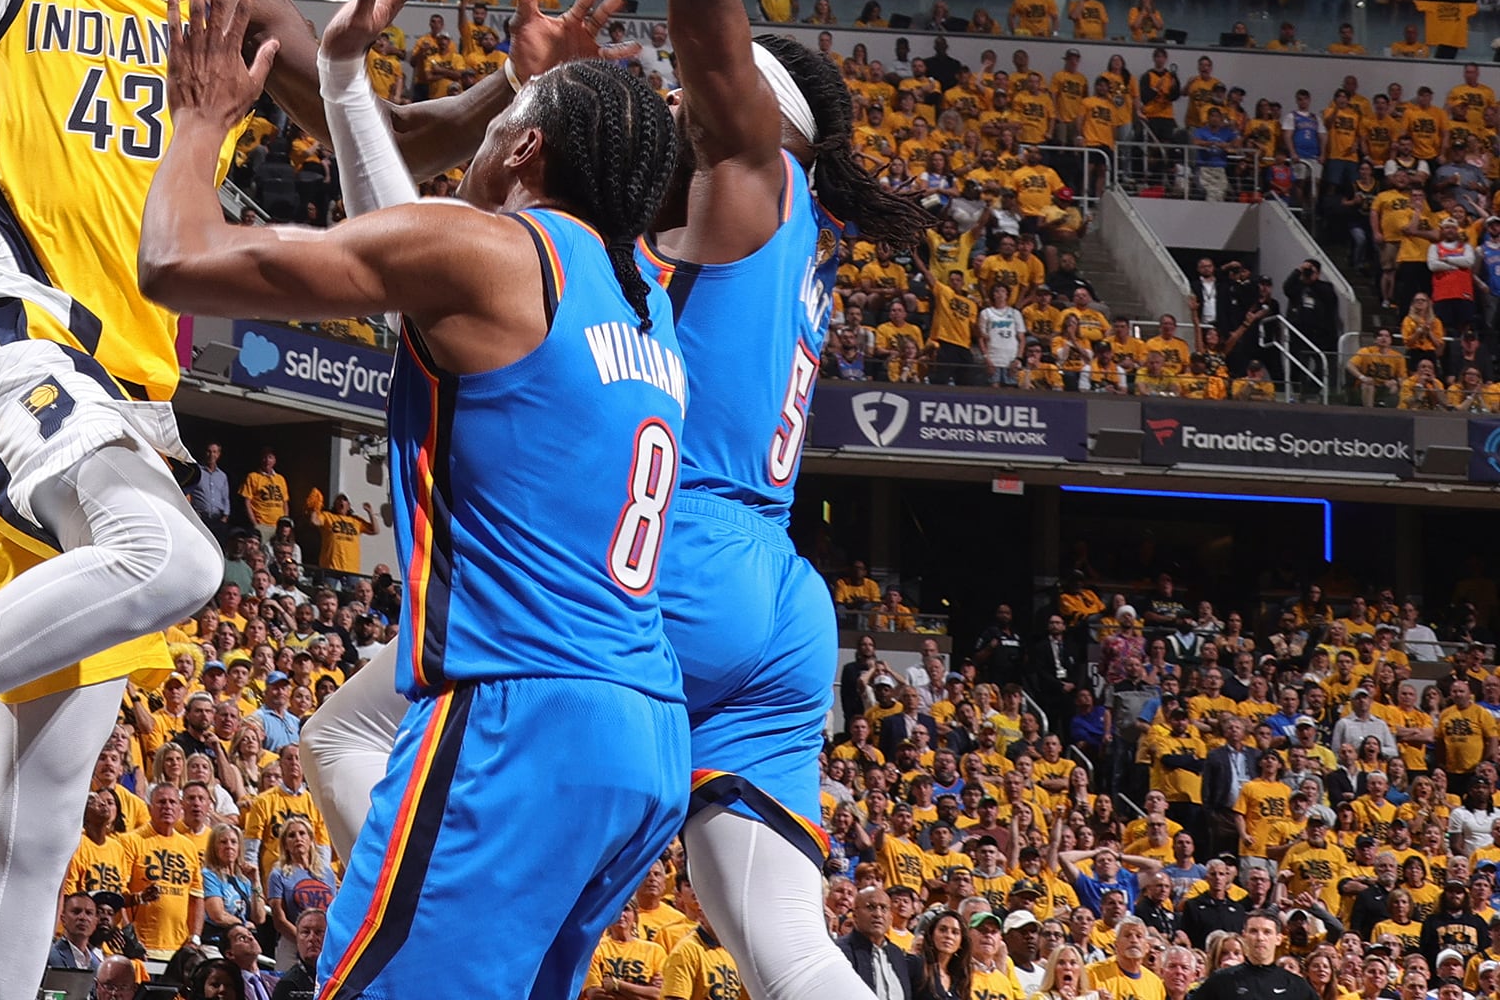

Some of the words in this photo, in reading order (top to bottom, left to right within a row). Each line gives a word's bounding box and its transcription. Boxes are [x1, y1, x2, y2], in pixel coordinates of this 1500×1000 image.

[25, 1, 172, 66] INDIAN
[65, 66, 168, 161] 43
[284, 346, 390, 399] salesforc
[583, 320, 687, 421] WILLIAM
[768, 336, 820, 488] 5
[919, 401, 1047, 429] FANDUEL
[919, 426, 976, 442] SPORTS
[977, 428, 1047, 446] NETWORK
[1181, 425, 1277, 452] Fanatics
[1278, 432, 1411, 459] Sportsbook
[606, 415, 679, 597] 8
[92, 862, 121, 883] YES
[145, 863, 191, 885] CERS
[151, 848, 186, 871] YES
[604, 956, 646, 975] YES
